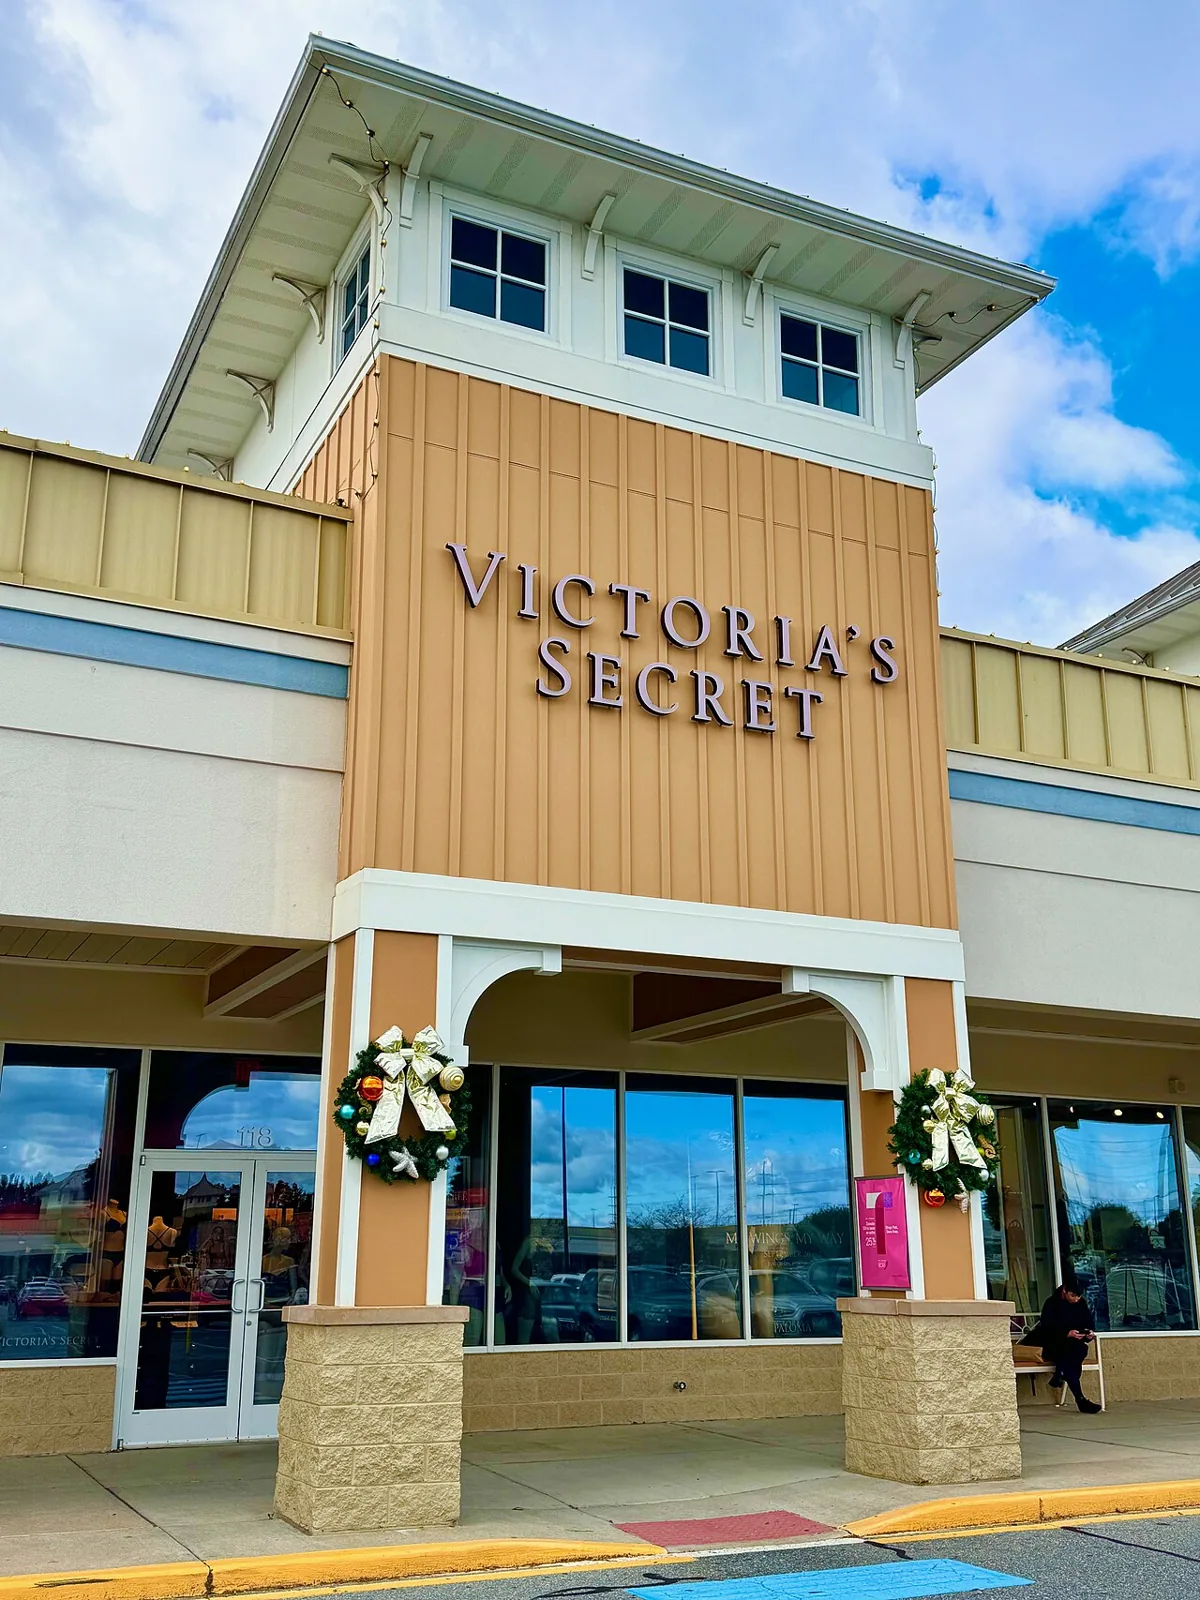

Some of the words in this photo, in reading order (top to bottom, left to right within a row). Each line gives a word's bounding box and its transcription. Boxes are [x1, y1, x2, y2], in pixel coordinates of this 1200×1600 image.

[444, 541, 899, 684] VICTORIA'S
[535, 636, 824, 740] SECRET
[236, 1126, 273, 1147] 118
[750, 1232, 791, 1245] WINGS
[796, 1232, 814, 1245] MY
[817, 1232, 845, 1245] WAY
[0, 1336, 56, 1347] ICTORIA'S
